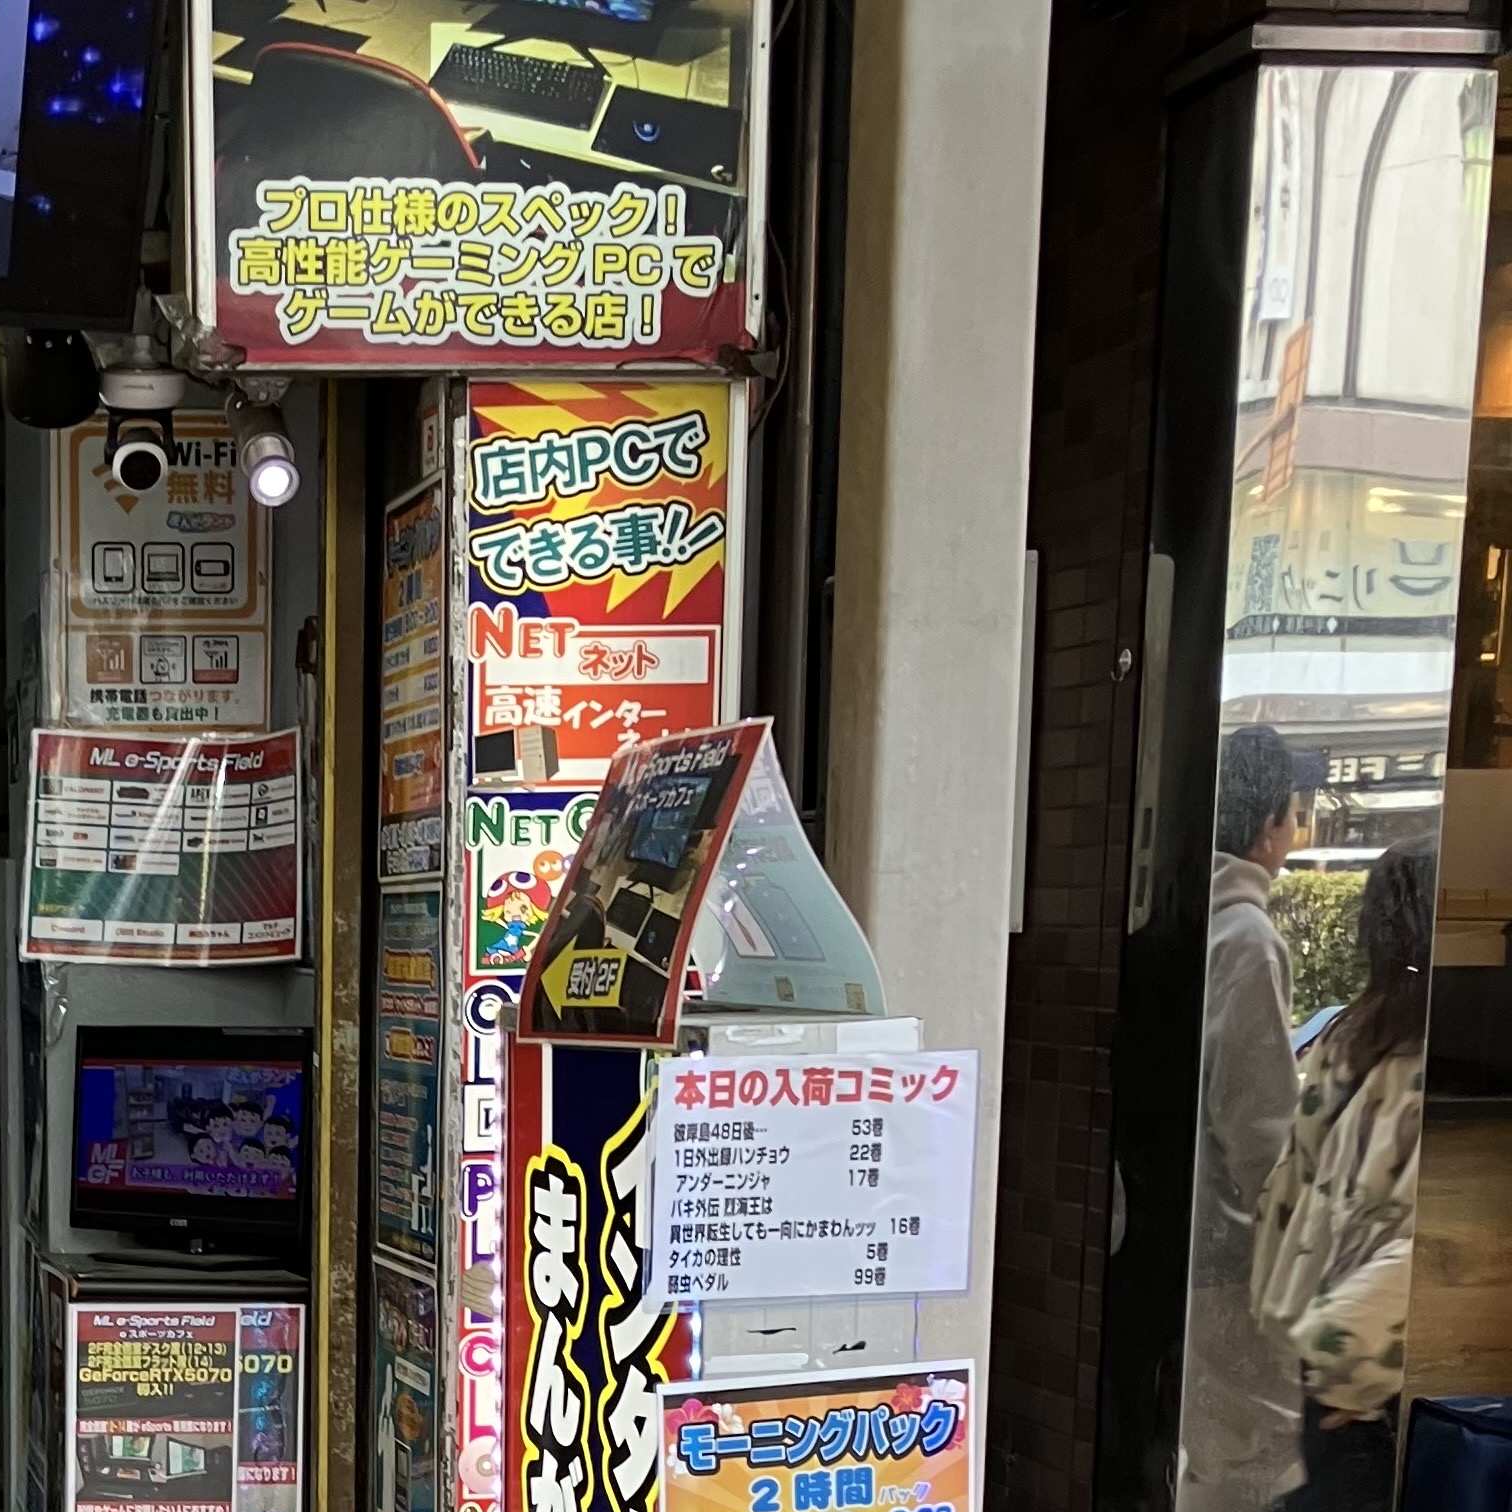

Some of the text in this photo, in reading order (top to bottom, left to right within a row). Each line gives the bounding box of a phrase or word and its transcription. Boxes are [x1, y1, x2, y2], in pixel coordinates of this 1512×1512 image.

[263, 186, 678, 235] プロ仕様のスペック！
[286, 290, 653, 337] ゲームができる店！
[171, 441, 237, 467] Wi-Fi
[478, 425, 702, 500] 店内PCで
[167, 470, 235, 504] 無料
[470, 606, 575, 658] NET
[580, 642, 658, 679] ネット
[484, 685, 667, 730] 高速インター
[89, 746, 121, 767] ML
[566, 957, 620, 998] 受付2F
[673, 1064, 960, 1110] 本日の入荷コミック
[851, 1117, 884, 1138] 53巻
[674, 1142, 882, 1169] 1日外出録ハンチョウ 22巻
[675, 1167, 880, 1193] アンダーニンジャ 17巻
[670, 1197, 721, 1219] バキ外伝
[889, 1215, 921, 1237] 16巻
[668, 1242, 889, 1269] タイカの理性 5巻
[667, 1267, 887, 1295] 弱虫ペダル 99巻
[181, 1315, 216, 1328] Field
[679, 1401, 960, 1472] モーニングパック
[793, 1467, 875, 1512] 時間
